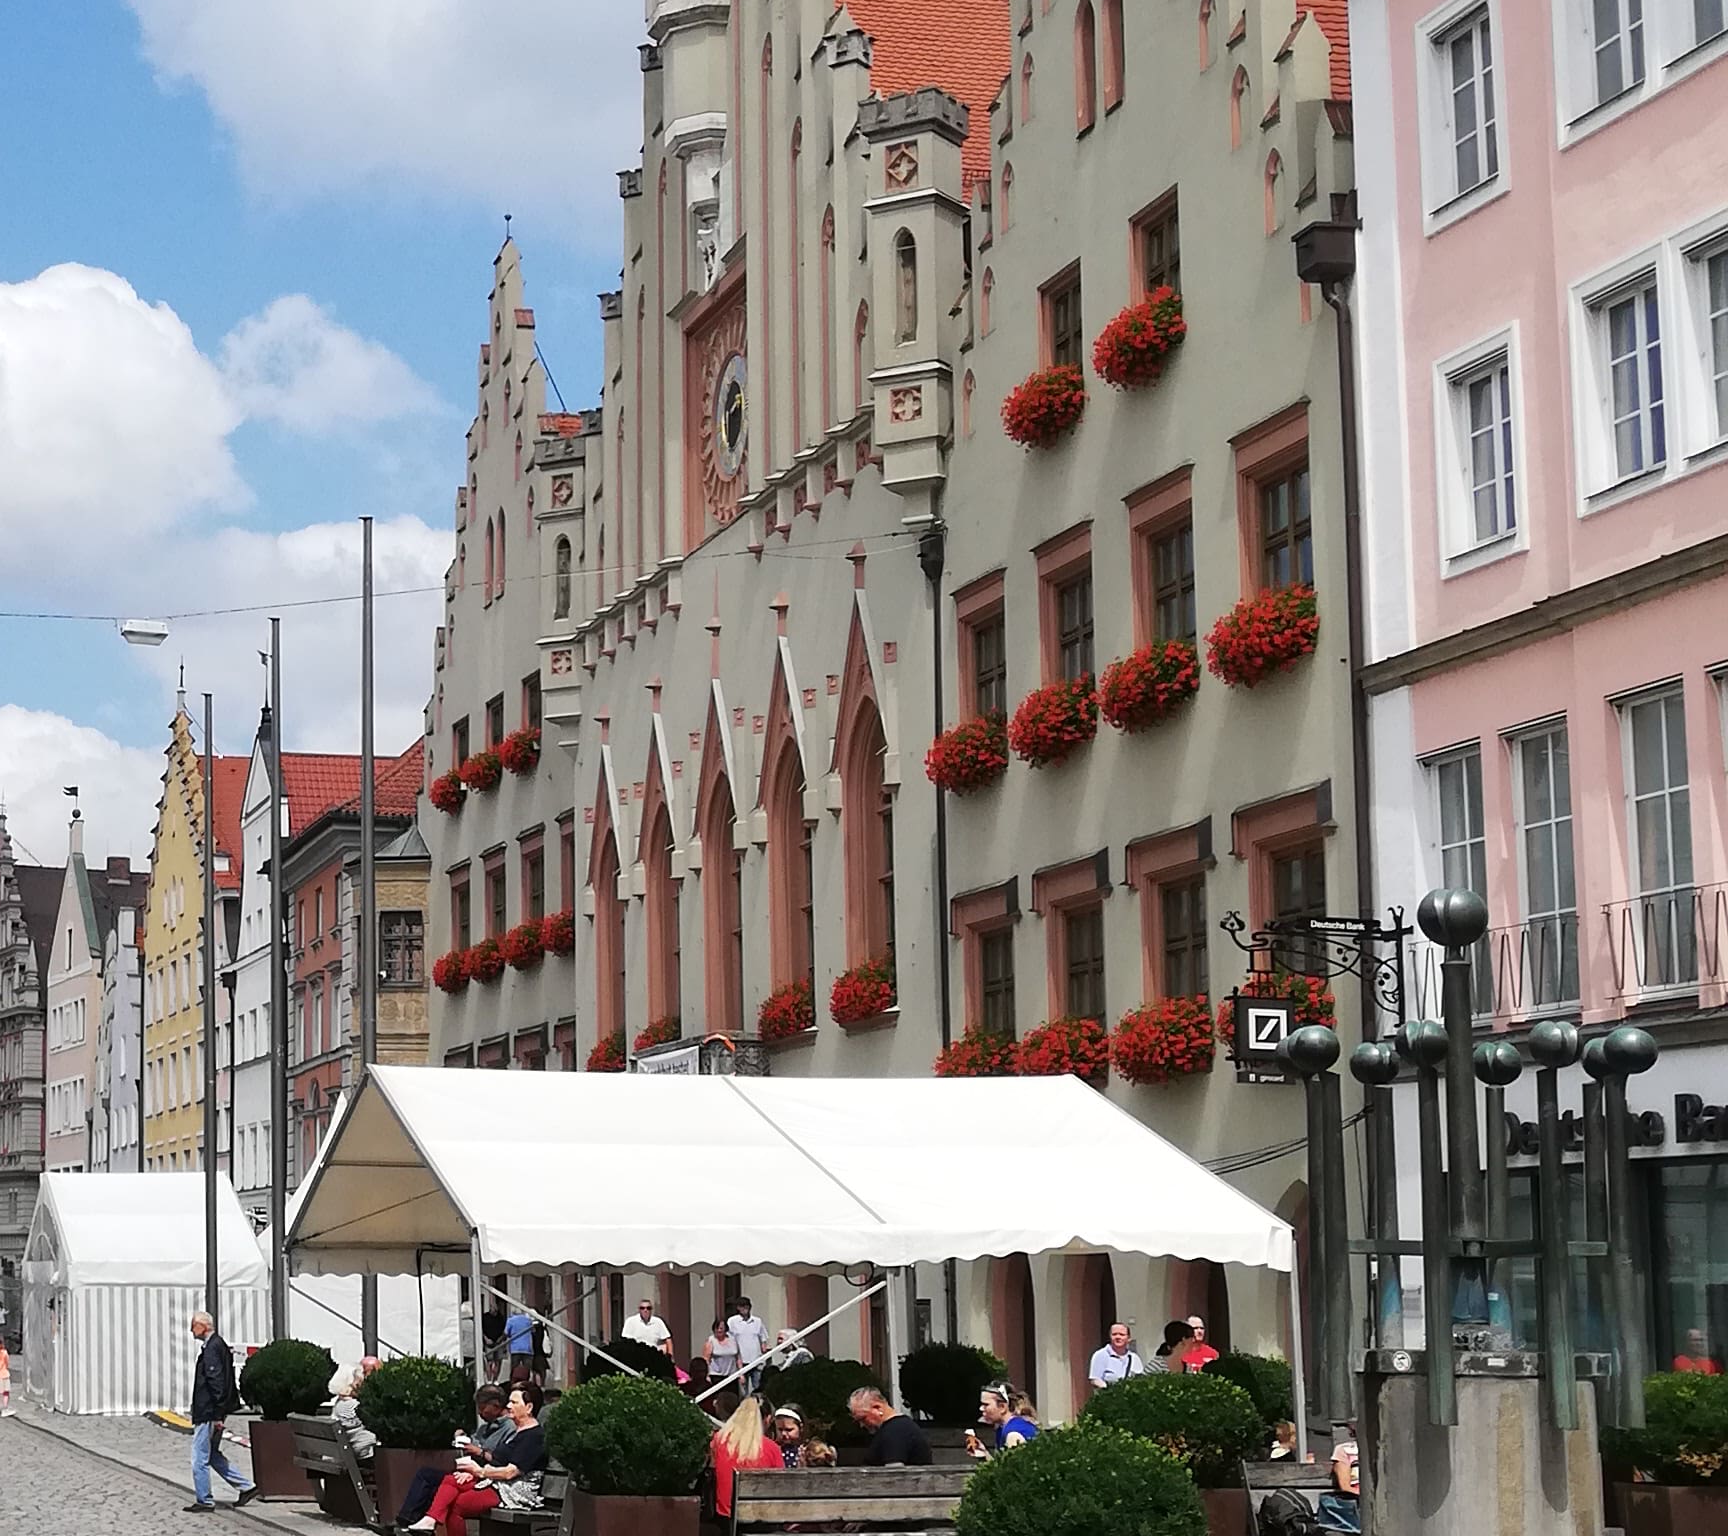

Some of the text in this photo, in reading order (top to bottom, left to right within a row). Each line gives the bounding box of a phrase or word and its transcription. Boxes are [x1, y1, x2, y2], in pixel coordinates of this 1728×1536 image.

[1310, 919, 1366, 931] Deutsche Bank
[1674, 1093, 1728, 1144] Ba
